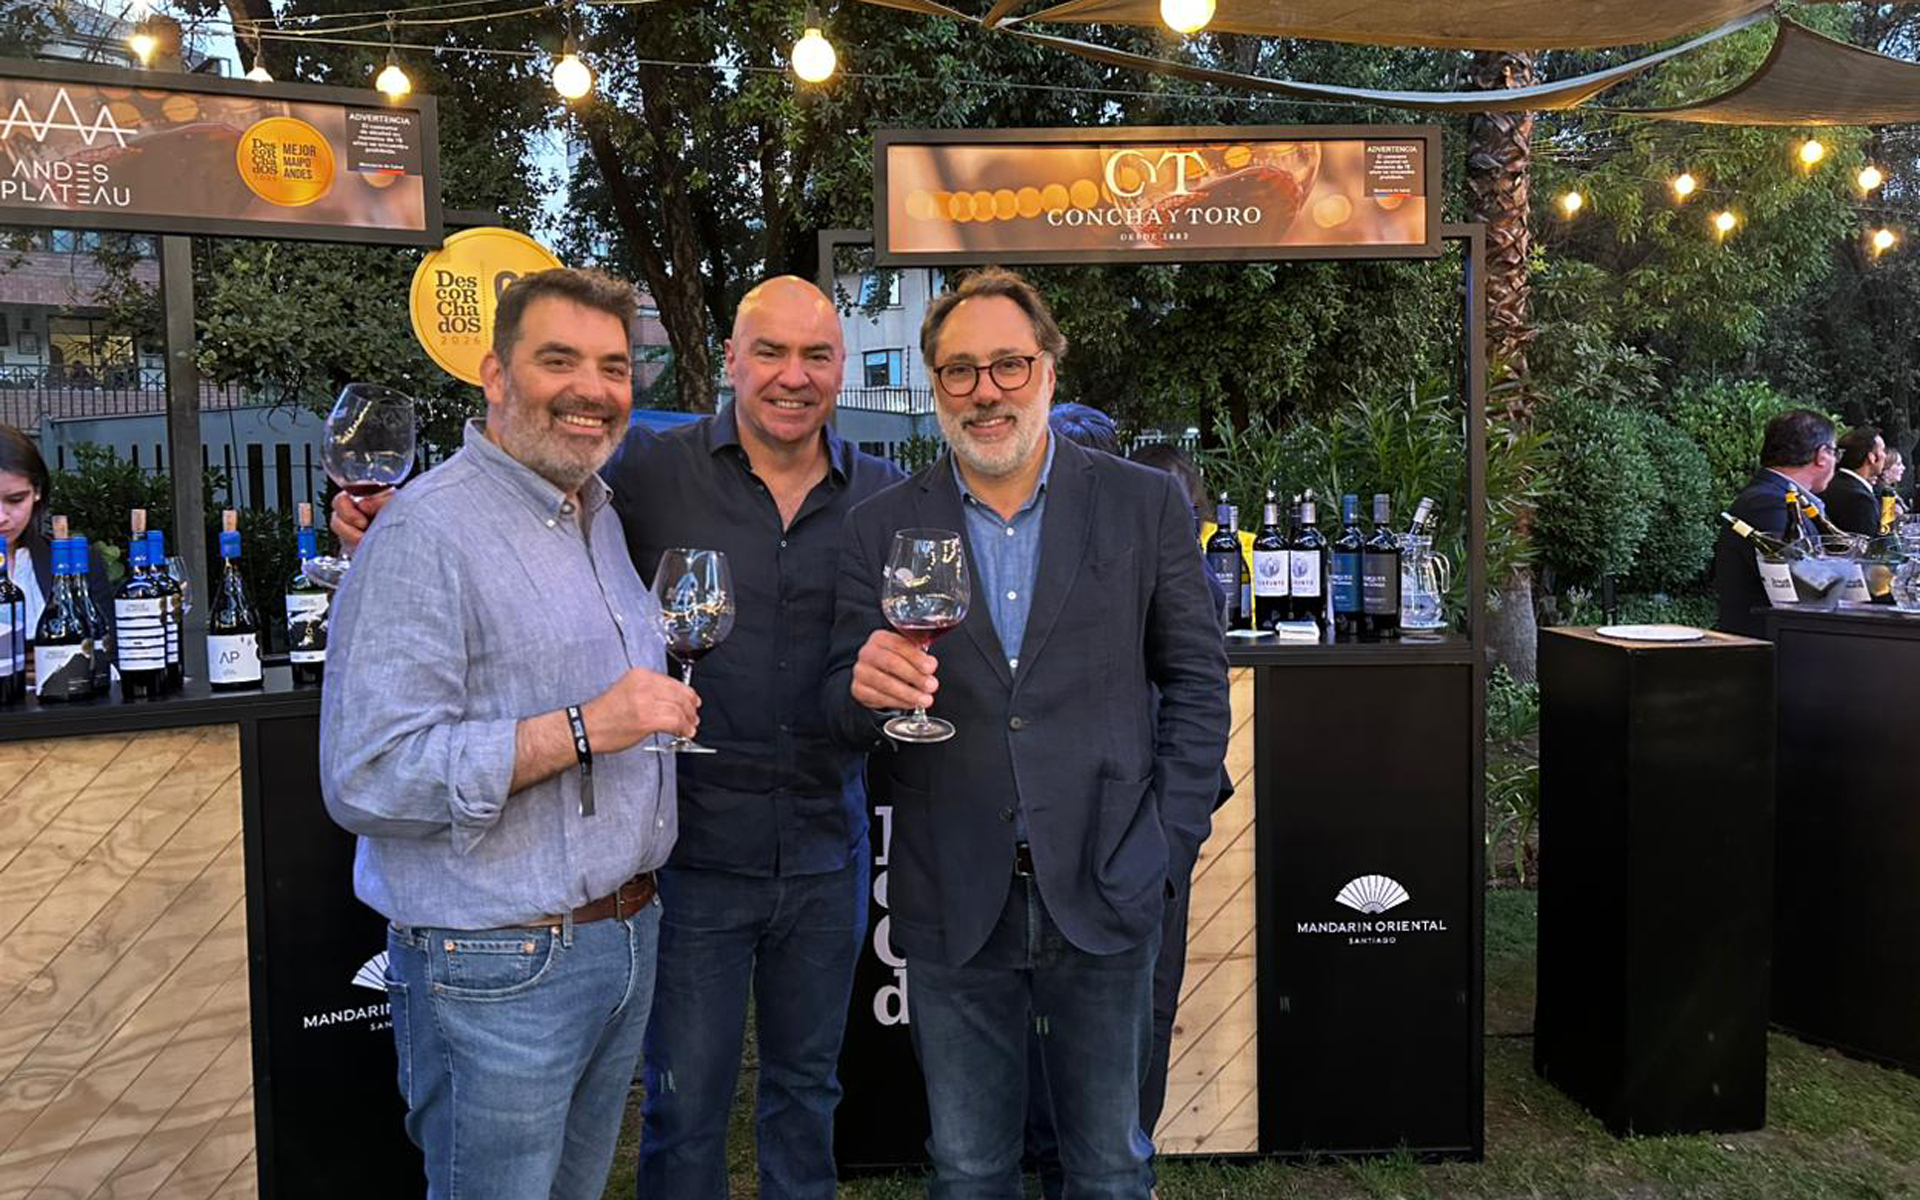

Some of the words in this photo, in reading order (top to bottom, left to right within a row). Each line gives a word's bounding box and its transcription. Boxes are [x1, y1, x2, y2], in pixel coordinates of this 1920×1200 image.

[283, 143, 316, 157] MEJOR
[283, 156, 312, 168] MAIPO
[12, 159, 109, 183] ANDES
[284, 167, 313, 180] ANDES
[1, 180, 131, 206] PLATEAU
[1047, 208, 1164, 226] CONCHA
[1167, 210, 1181, 224] Y
[1184, 206, 1262, 226] TORO
[435, 270, 478, 288] Des
[1297, 921, 1372, 933] MANDARIN
[1375, 920, 1447, 932] ORIENTAL
[1349, 937, 1397, 945] SANTIAGO
